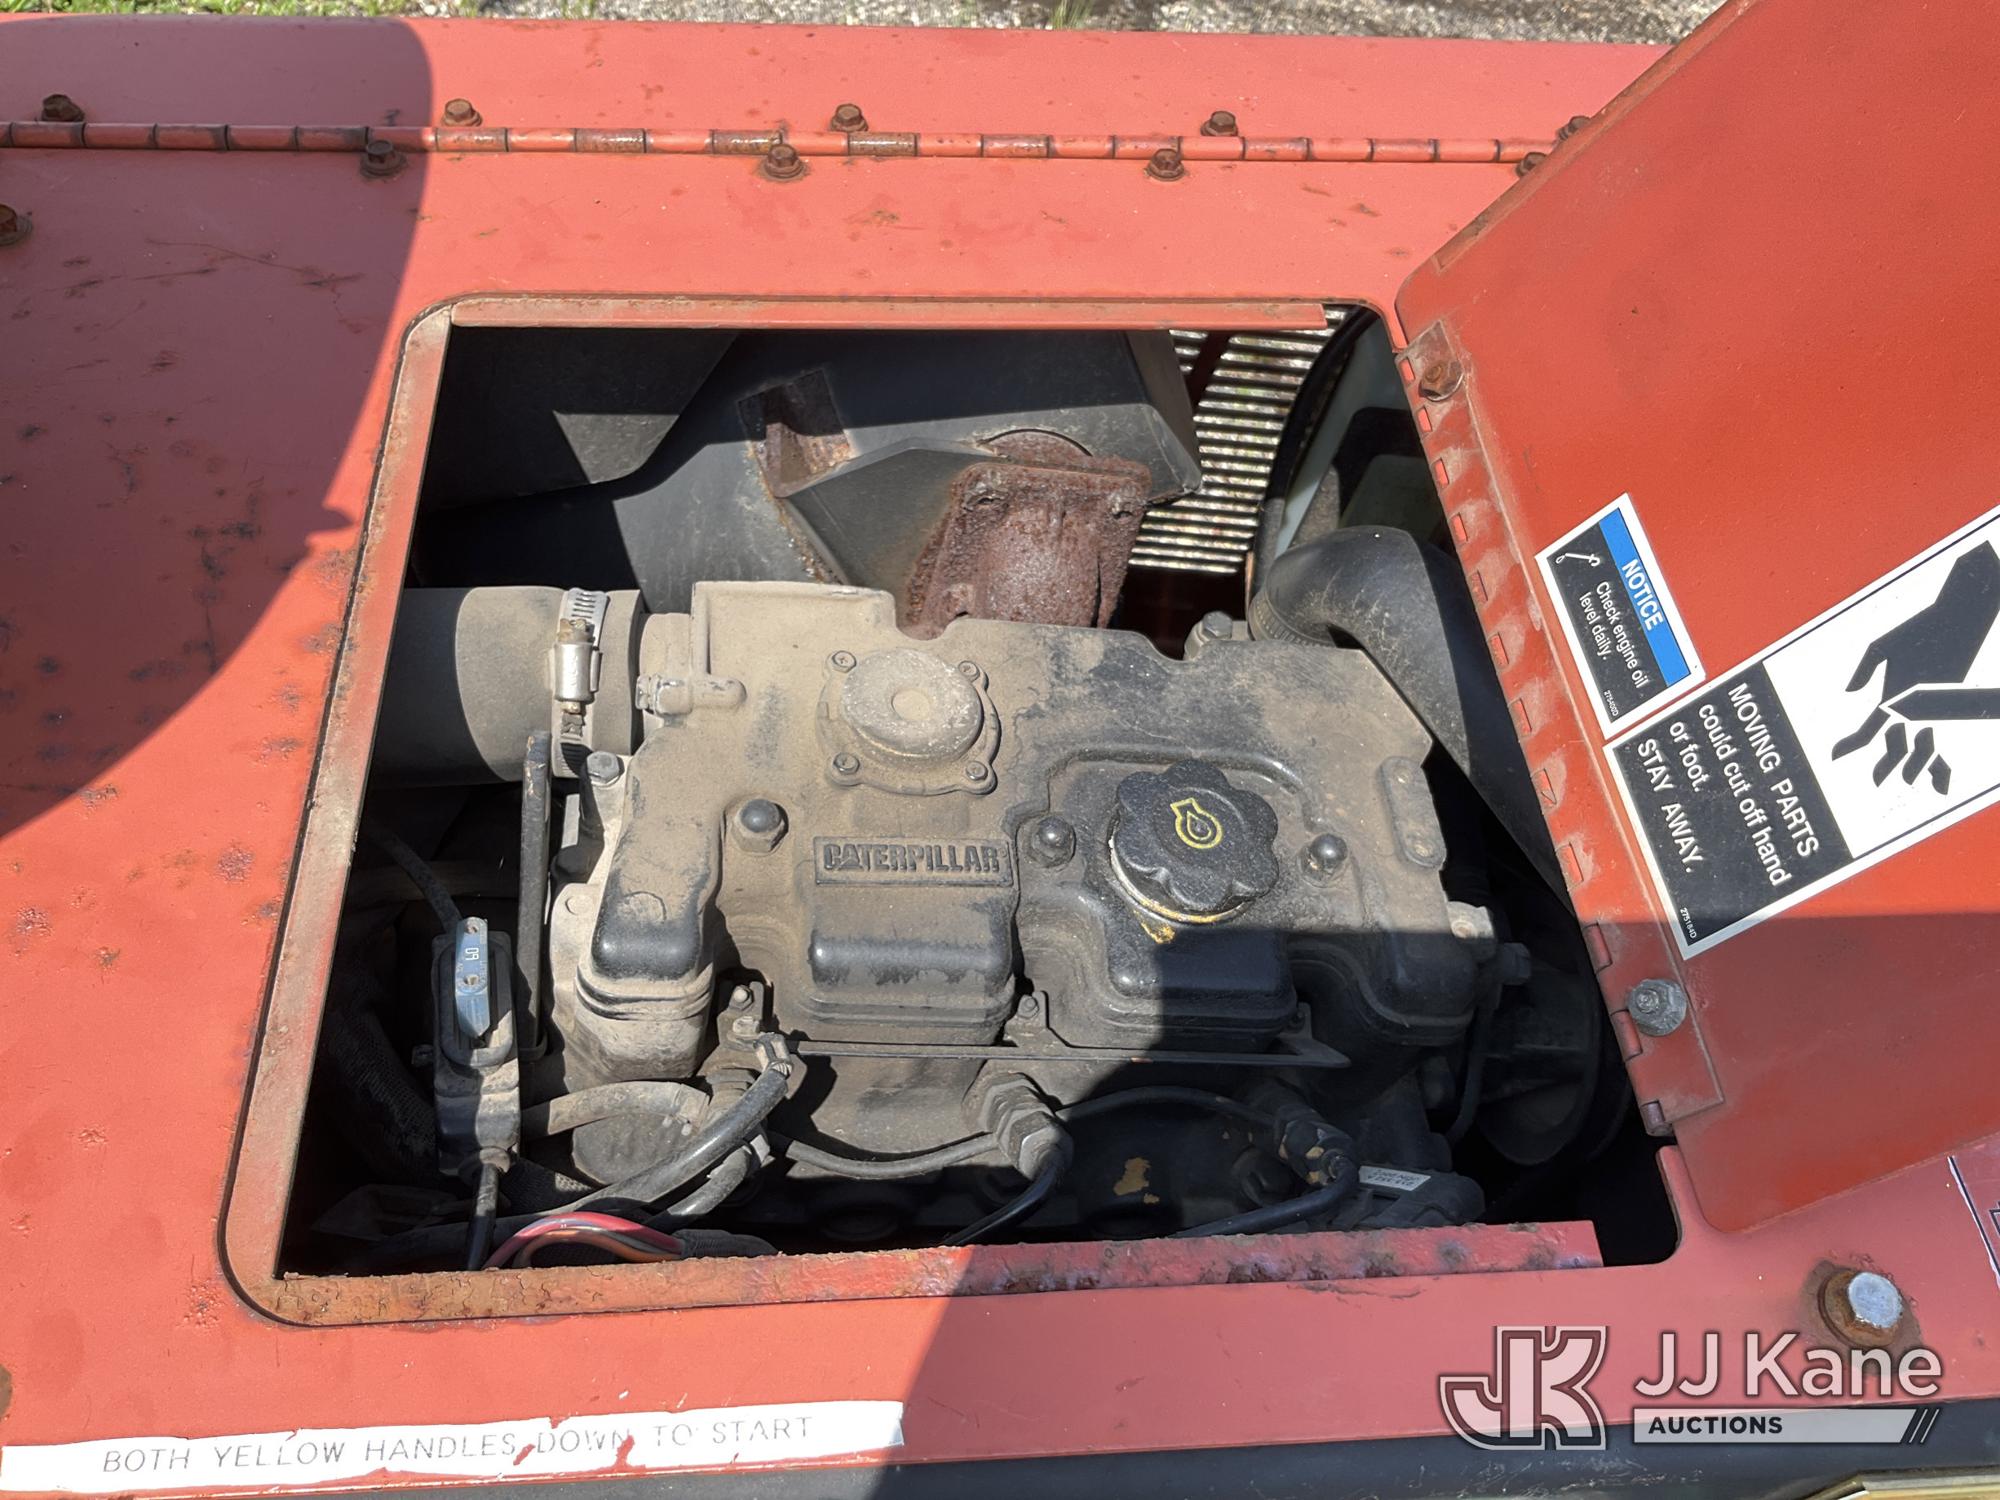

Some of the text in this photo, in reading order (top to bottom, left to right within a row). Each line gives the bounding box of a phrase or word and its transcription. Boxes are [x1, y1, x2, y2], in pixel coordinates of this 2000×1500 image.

[1579, 591, 1612, 661] level daily.
[1621, 558, 1664, 631] NOTICE
[1596, 581, 1649, 689] Check engine oil
[1669, 721, 1711, 793] or foot.
[1728, 682, 1819, 858] MOVING PARTS
[1637, 738, 1703, 873] STAY AWAY.
[1698, 704, 1793, 887] could cut off hand
[823, 843, 1001, 873] CATERPILLAR
[102, 1416, 814, 1473] BOTH YELLOW HANDLES DOWN TO START
